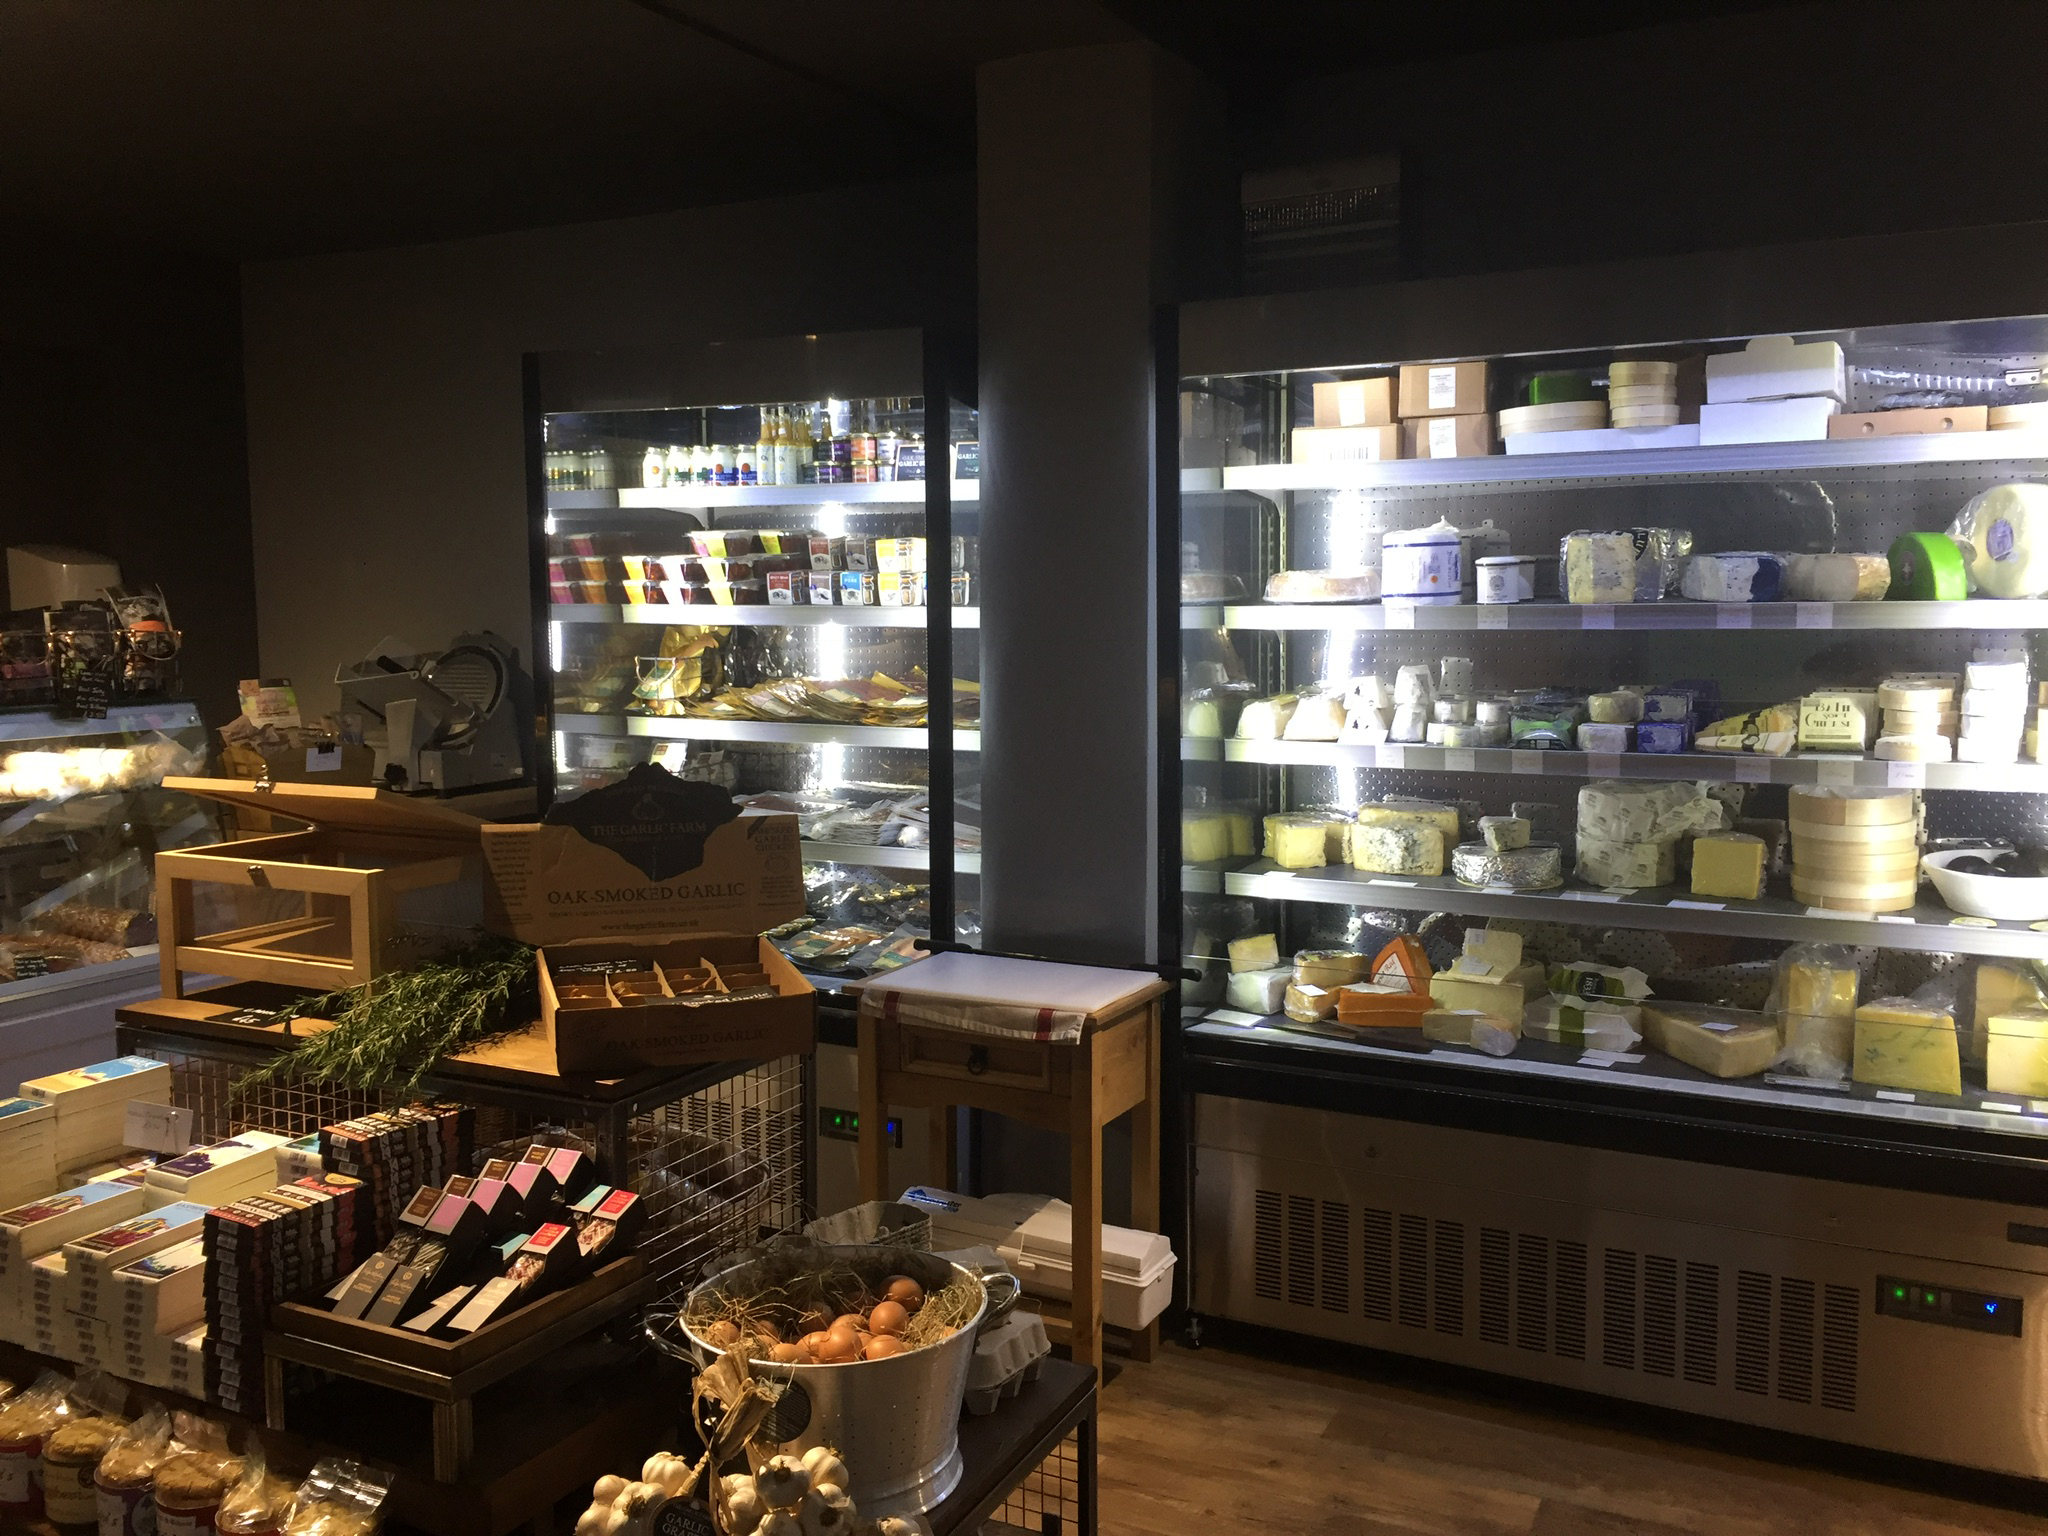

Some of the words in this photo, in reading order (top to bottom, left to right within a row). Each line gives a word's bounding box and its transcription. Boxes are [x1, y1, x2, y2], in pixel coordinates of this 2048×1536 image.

[592, 825, 618, 836] THE
[620, 824, 664, 835] GARLIC
[670, 822, 706, 833] FARM
[547, 886, 673, 904] OAK-SMOKED
[678, 882, 746, 899] GARLIC
[606, 1033, 709, 1050] OAK-SMOKED
[713, 1027, 769, 1043] GARLIC
[665, 1513, 710, 1535] GARLIC
